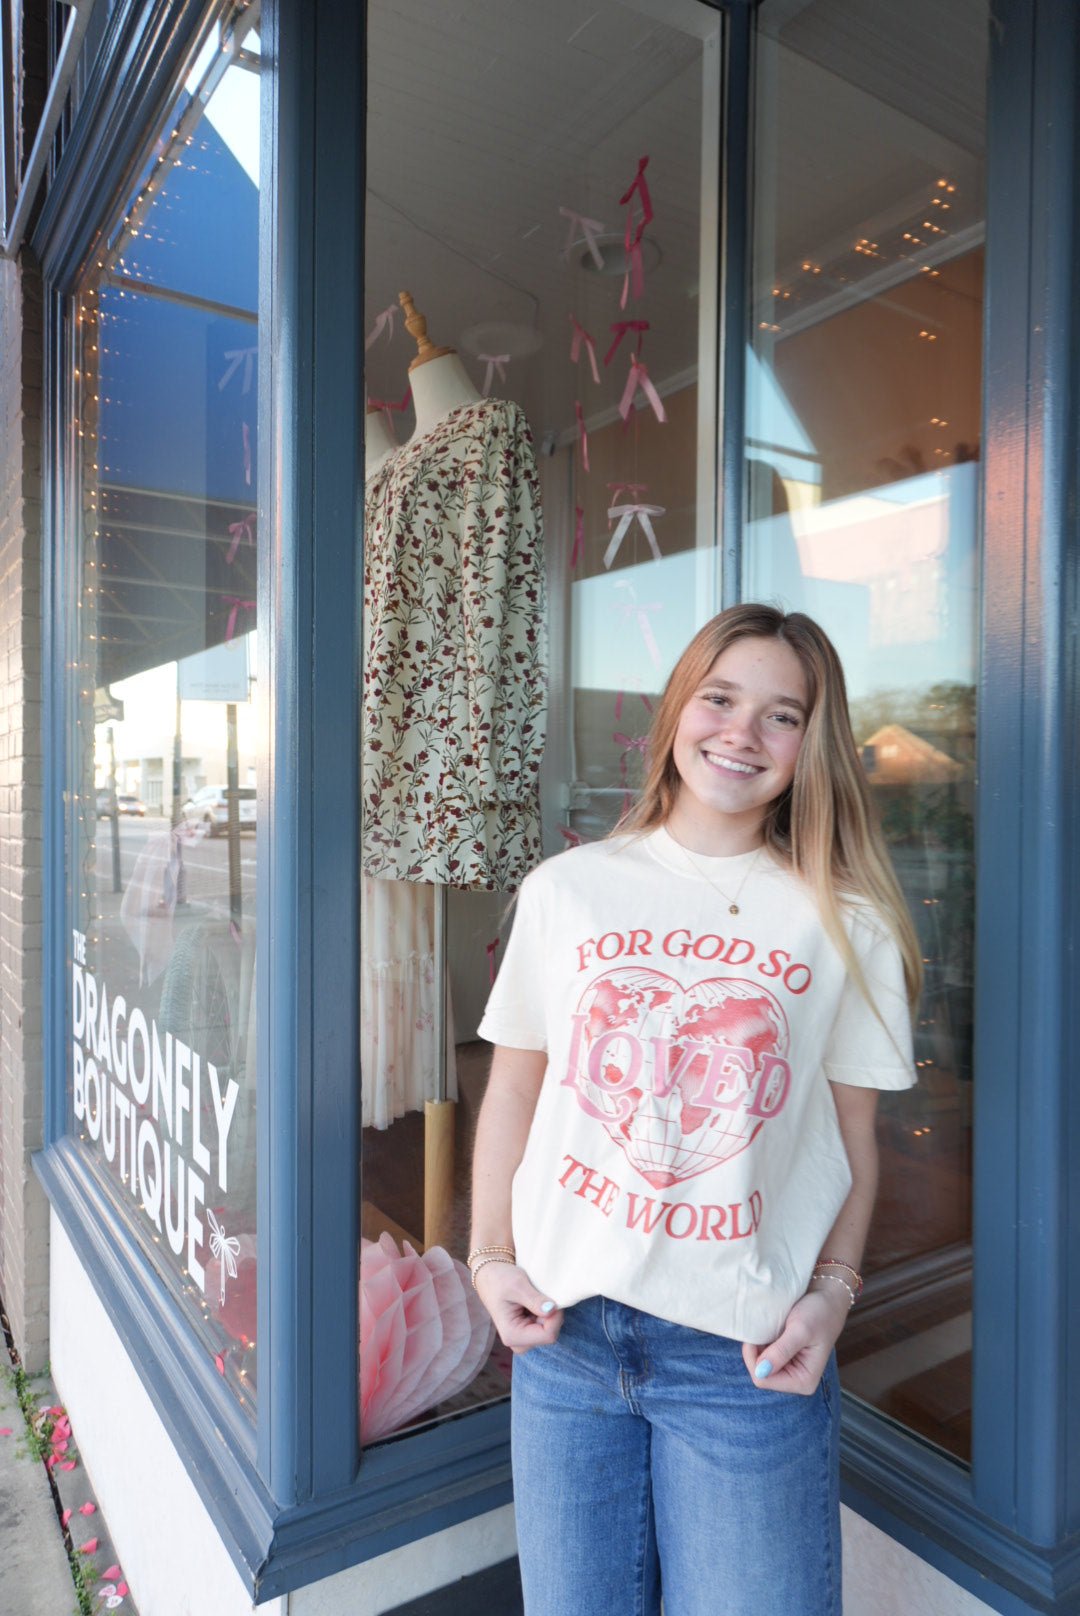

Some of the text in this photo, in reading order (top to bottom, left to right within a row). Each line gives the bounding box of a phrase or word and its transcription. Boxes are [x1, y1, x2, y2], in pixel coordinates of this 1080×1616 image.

[72, 928, 87, 966] THE
[576, 929, 812, 995] FOR GOD SO
[72, 961, 239, 1194] DRAGONFLY
[560, 1013, 792, 1123] LOVED
[72, 1040, 206, 1294] BOUTIQUE
[558, 1154, 762, 1241] THE WORLD
